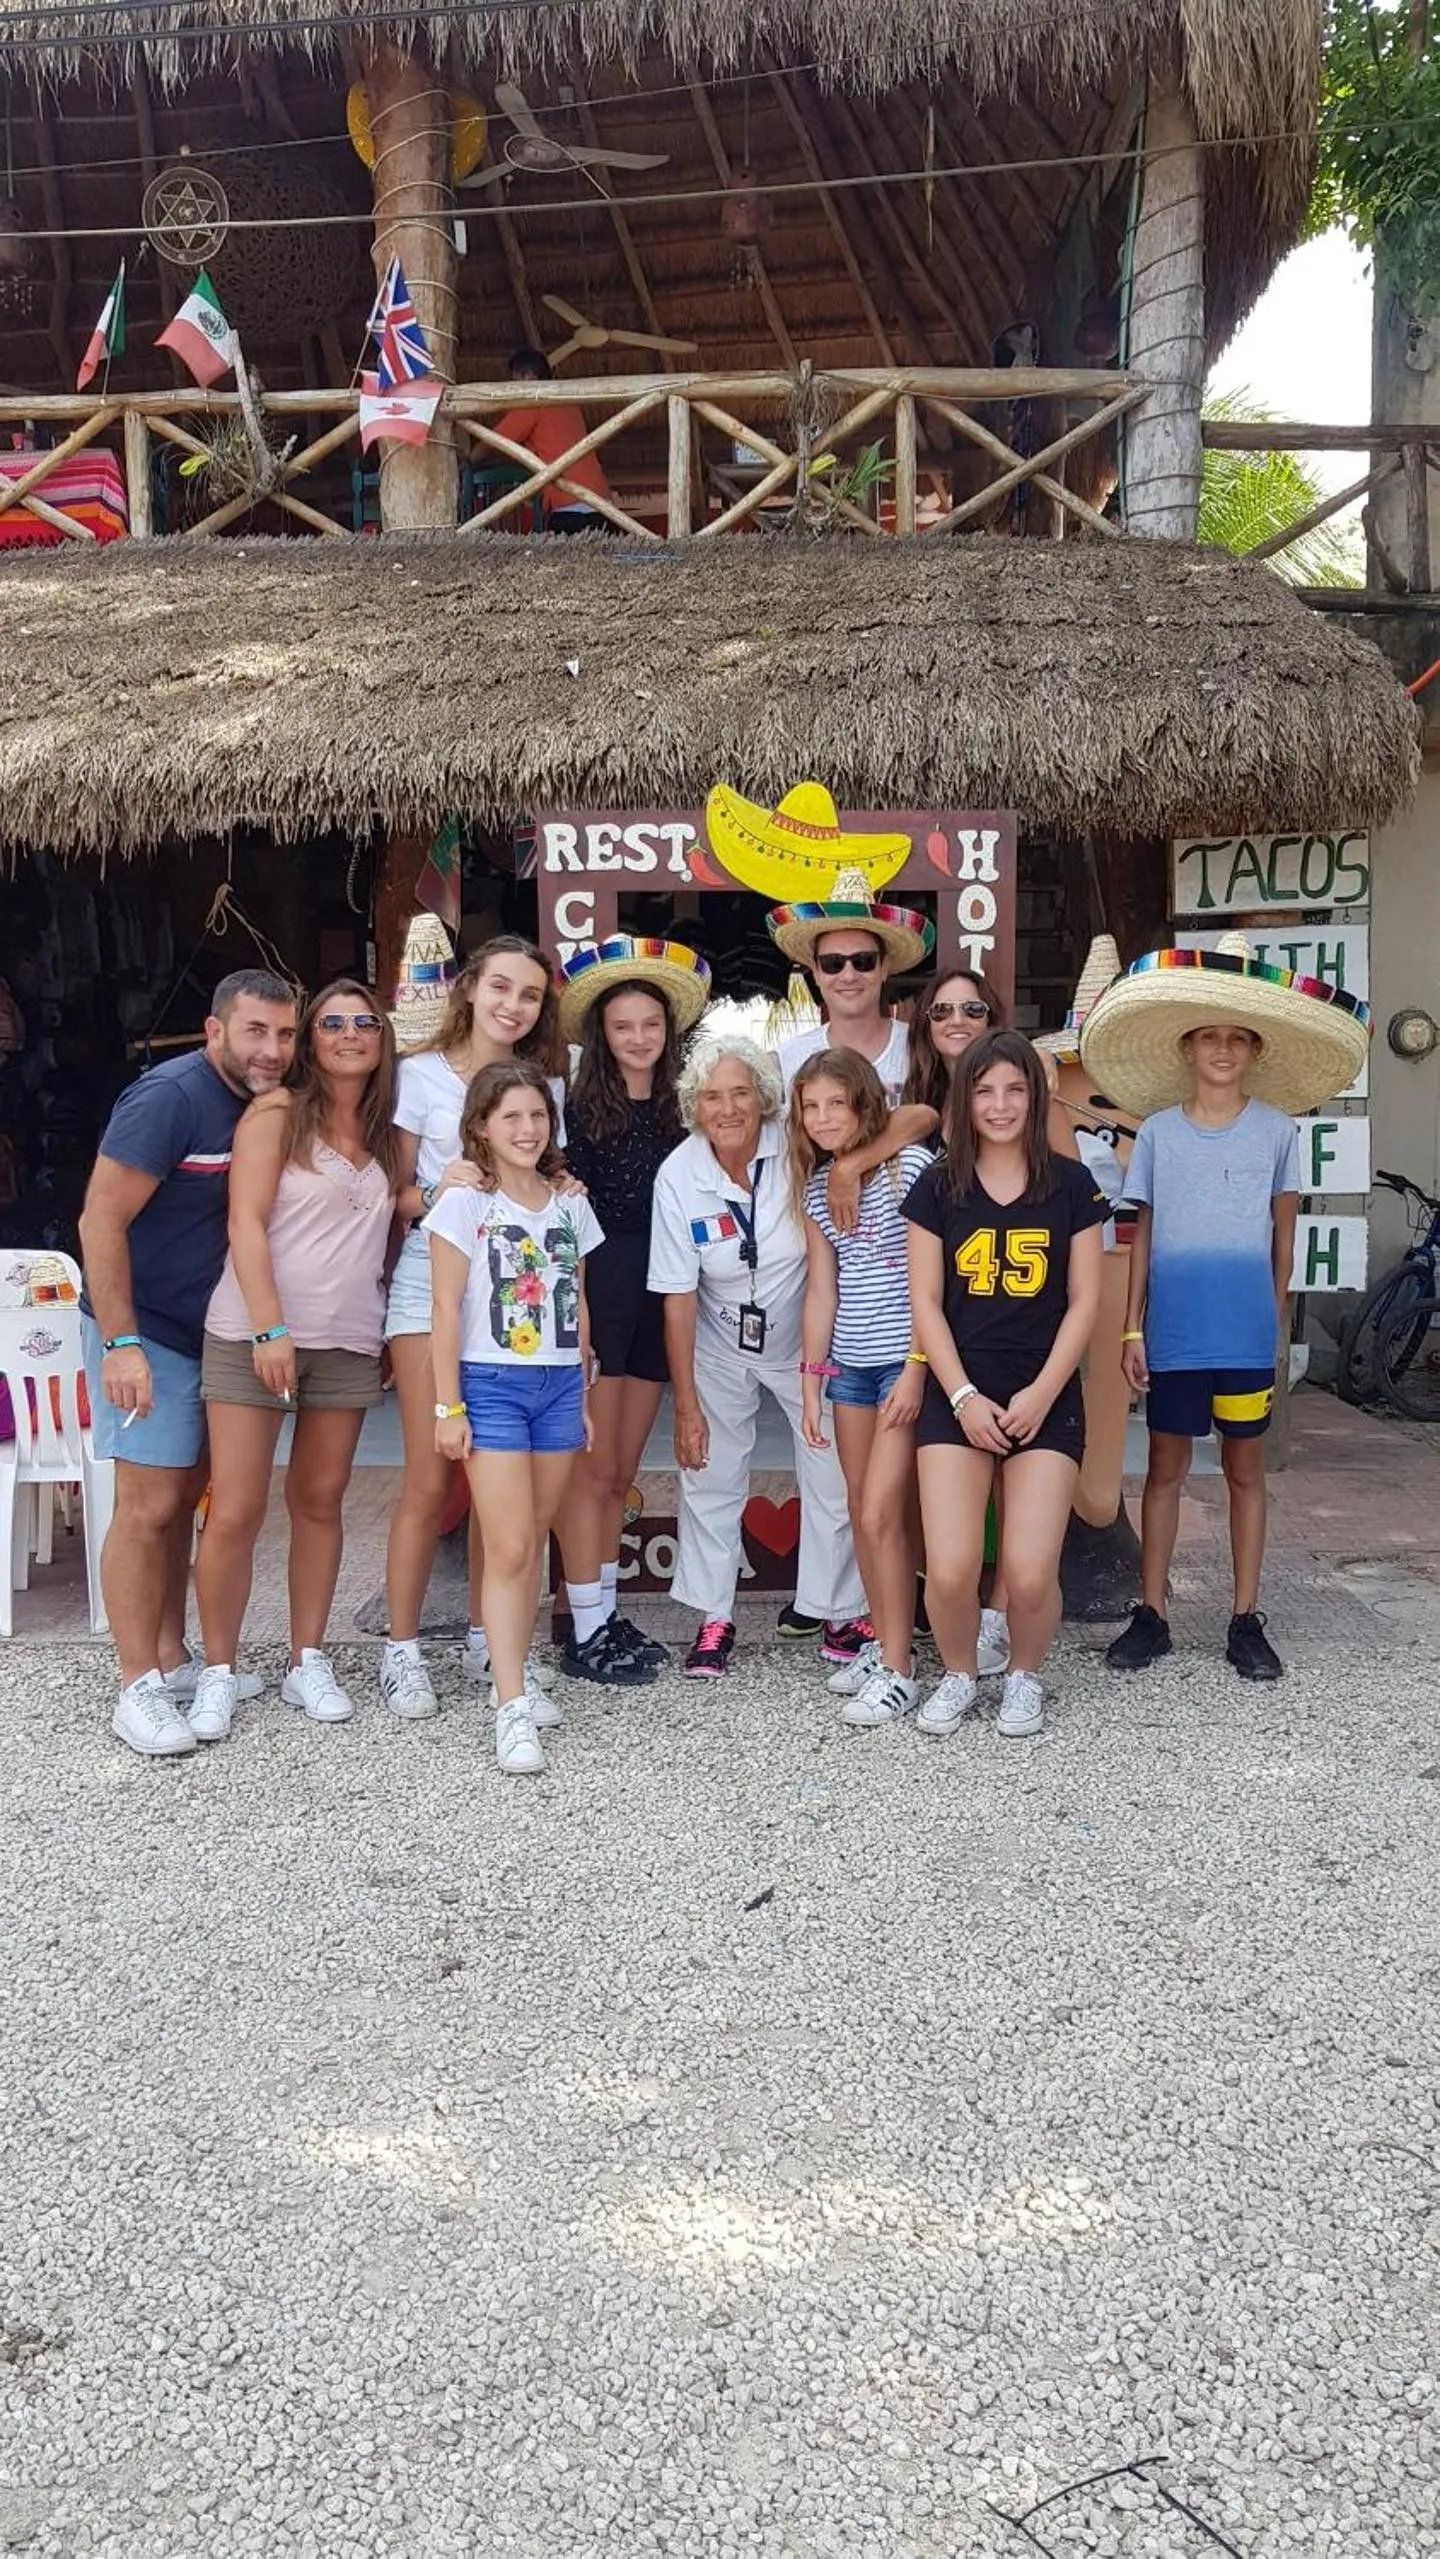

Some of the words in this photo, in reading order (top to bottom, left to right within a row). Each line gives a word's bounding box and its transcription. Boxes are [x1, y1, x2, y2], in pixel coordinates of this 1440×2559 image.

[543, 823, 696, 882] REST.
[1178, 832, 1369, 908] TACOS
[957, 829, 1000, 977] HOT
[955, 1227, 1050, 1297] 45
